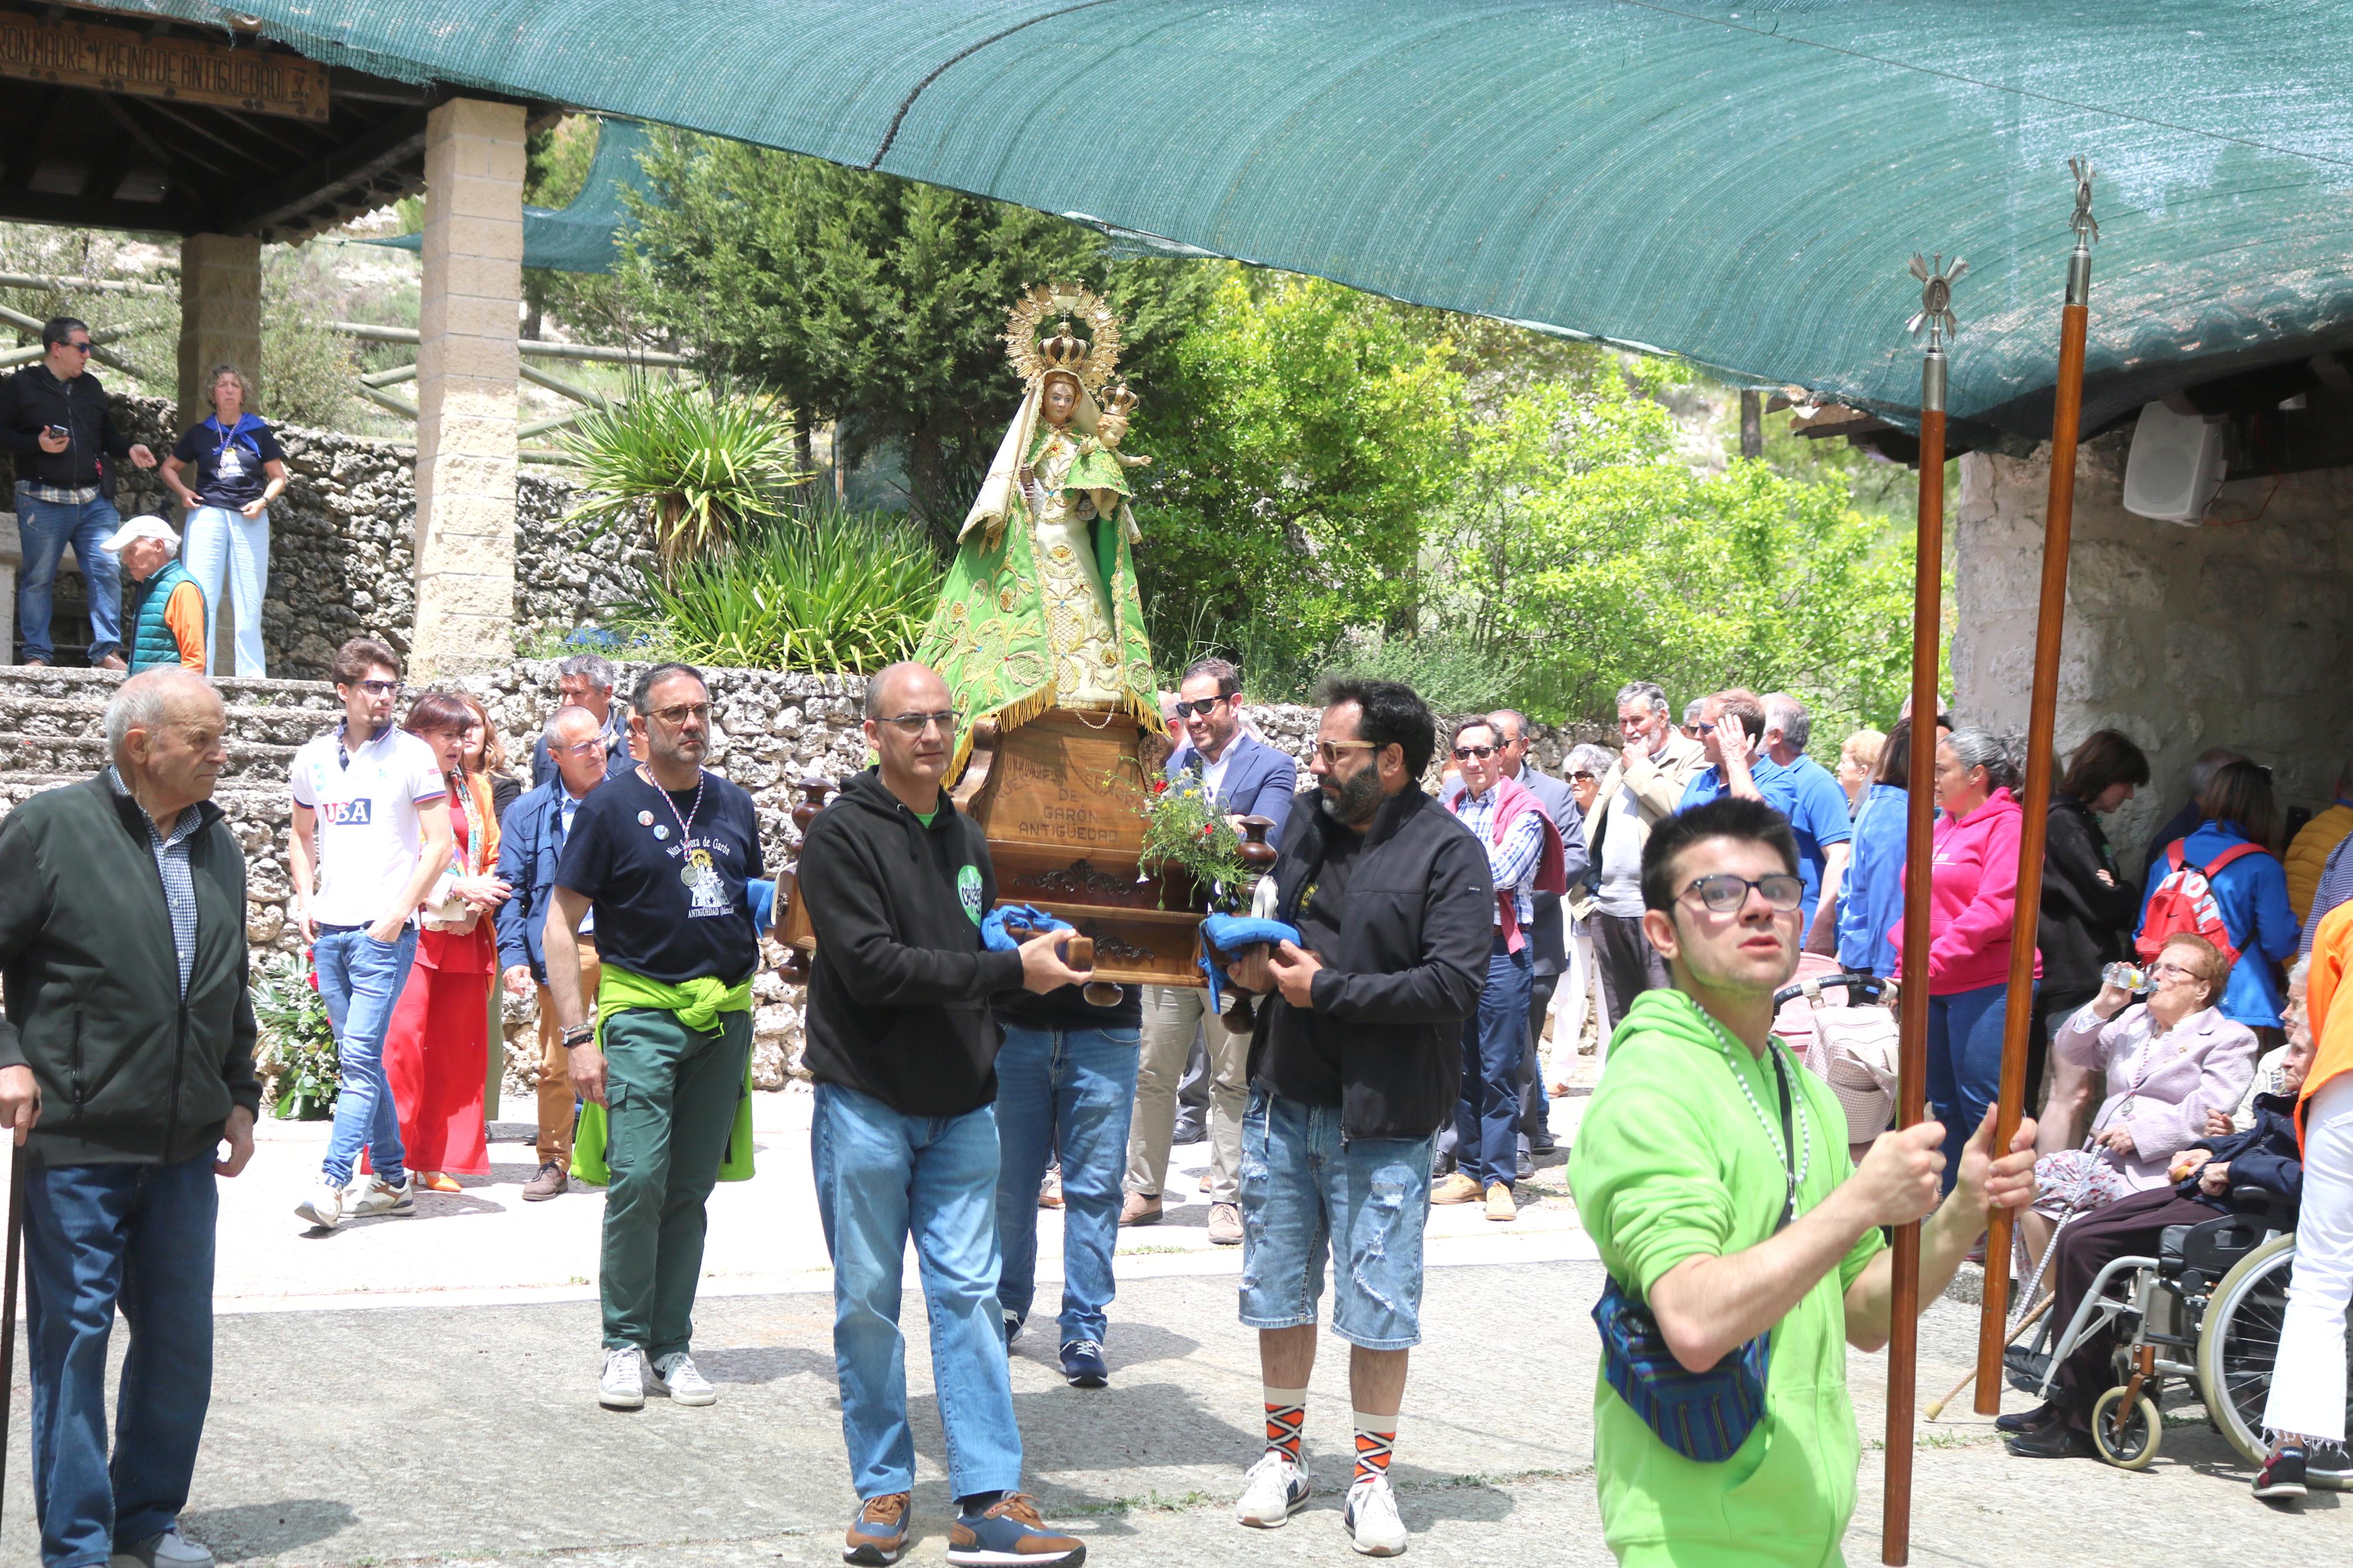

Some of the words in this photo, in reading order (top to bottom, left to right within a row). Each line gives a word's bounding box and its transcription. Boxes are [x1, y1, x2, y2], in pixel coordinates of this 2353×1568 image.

[33, 30, 86, 70] MADRE
[93, 39, 102, 73] Y
[106, 41, 152, 81] REINA
[157, 50, 177, 84] DE
[1059, 790, 1080, 802] DE
[322, 801, 368, 823] USA
[1043, 805, 1099, 823] GARÓN
[1019, 823, 1118, 842] ANTIGÜEDAD
[702, 835, 711, 847] de
[712, 838, 731, 856] Garón
[688, 906, 719, 919] ANTIGÜEDAD
